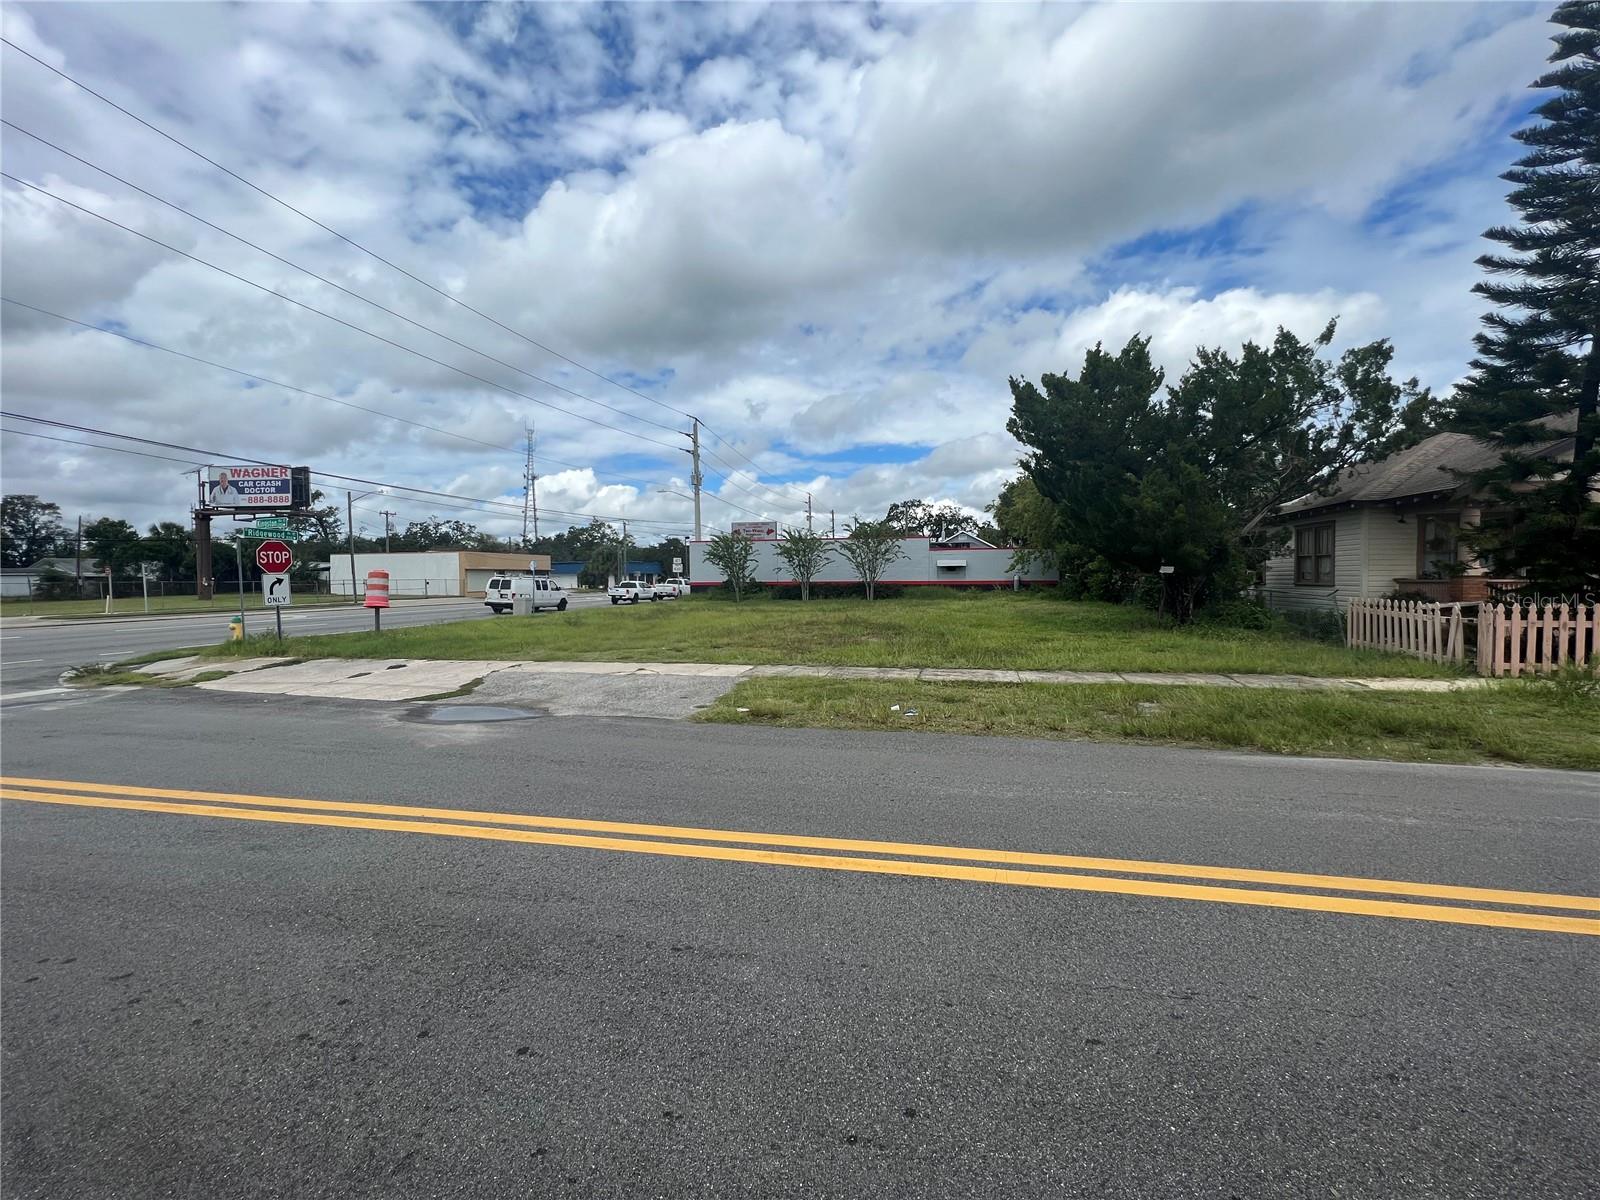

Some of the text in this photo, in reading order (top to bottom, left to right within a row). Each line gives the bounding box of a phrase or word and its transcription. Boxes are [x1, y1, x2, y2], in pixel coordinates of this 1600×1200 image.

[230, 467, 288, 478] WAGNER
[247, 495, 290, 504] 888-8888
[247, 529, 285, 539] Ridgewood
[259, 551, 290, 563] STOP
